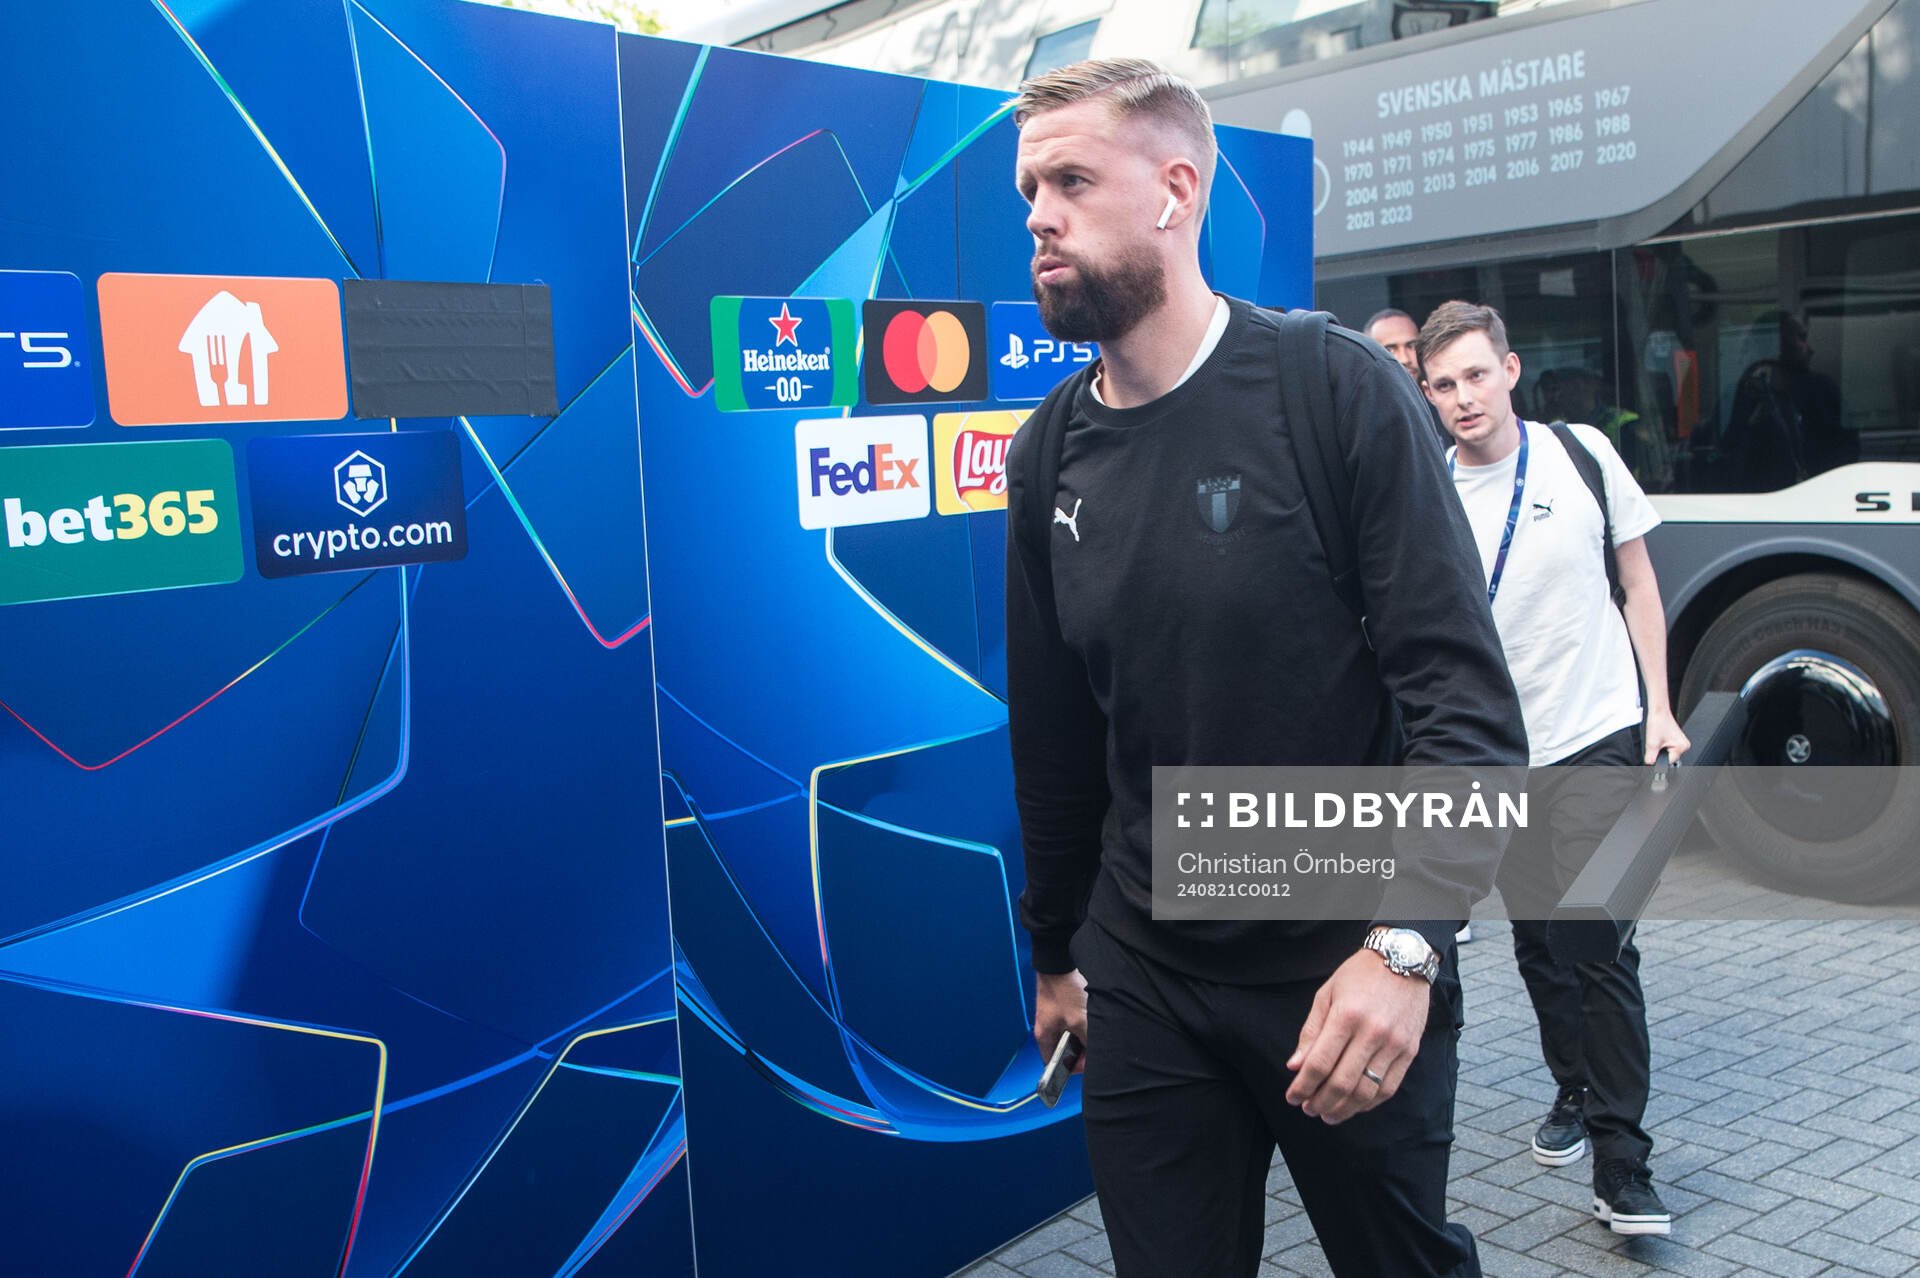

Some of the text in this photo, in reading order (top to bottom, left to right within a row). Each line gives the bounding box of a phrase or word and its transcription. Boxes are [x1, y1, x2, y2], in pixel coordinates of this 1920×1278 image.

[1377, 50, 1586, 119] SVENSKA MÄSTARE
[1343, 85, 1631, 158] 1944 1949 1950 1951 1953 1965 1967
[1344, 113, 1631, 182] 1970 1971 1974 1975 1977 1986 1988
[1346, 140, 1637, 207] 2004 2010 2013 2014 2016 2017 2020
[1346, 204, 1413, 231] 2021 2023
[0, 332, 72, 368] 5
[742, 349, 830, 372] Heineken
[1033, 339, 1093, 363] PS5
[809, 443, 920, 498] FedEx
[4, 489, 219, 548] bet365
[1855, 492, 1920, 511] S
[272, 516, 453, 559] crypto.com
